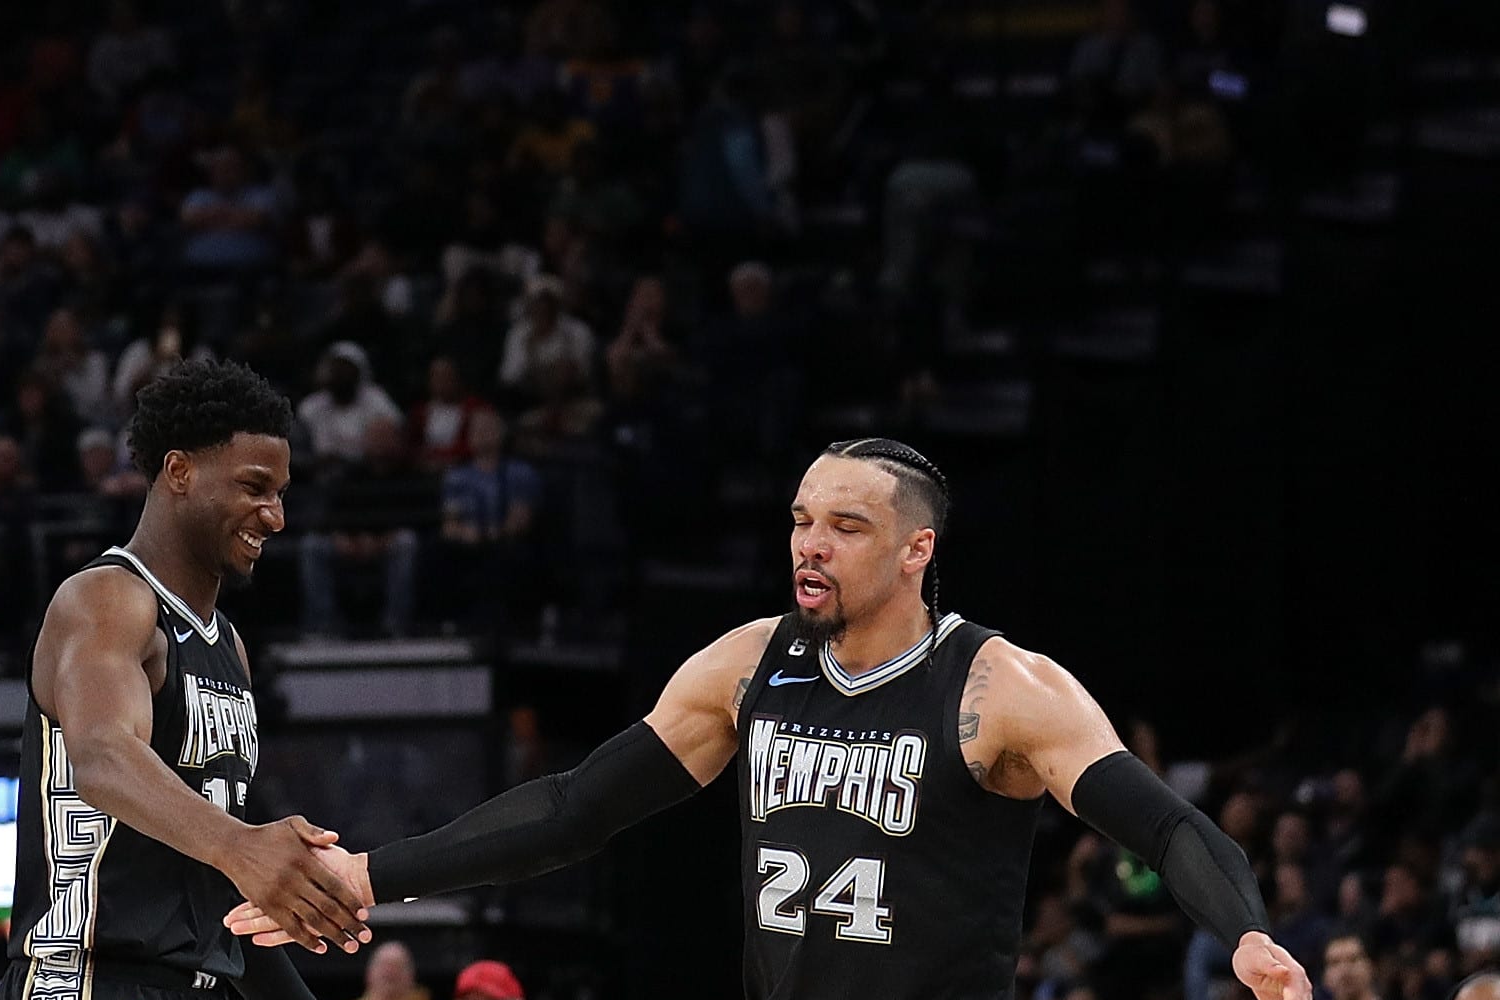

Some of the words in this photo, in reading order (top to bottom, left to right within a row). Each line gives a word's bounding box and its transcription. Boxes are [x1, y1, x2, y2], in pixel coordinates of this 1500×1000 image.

[750, 718, 927, 836] MEMPHIS
[780, 722, 891, 740] GRIZZLIES
[757, 847, 892, 944] 24
